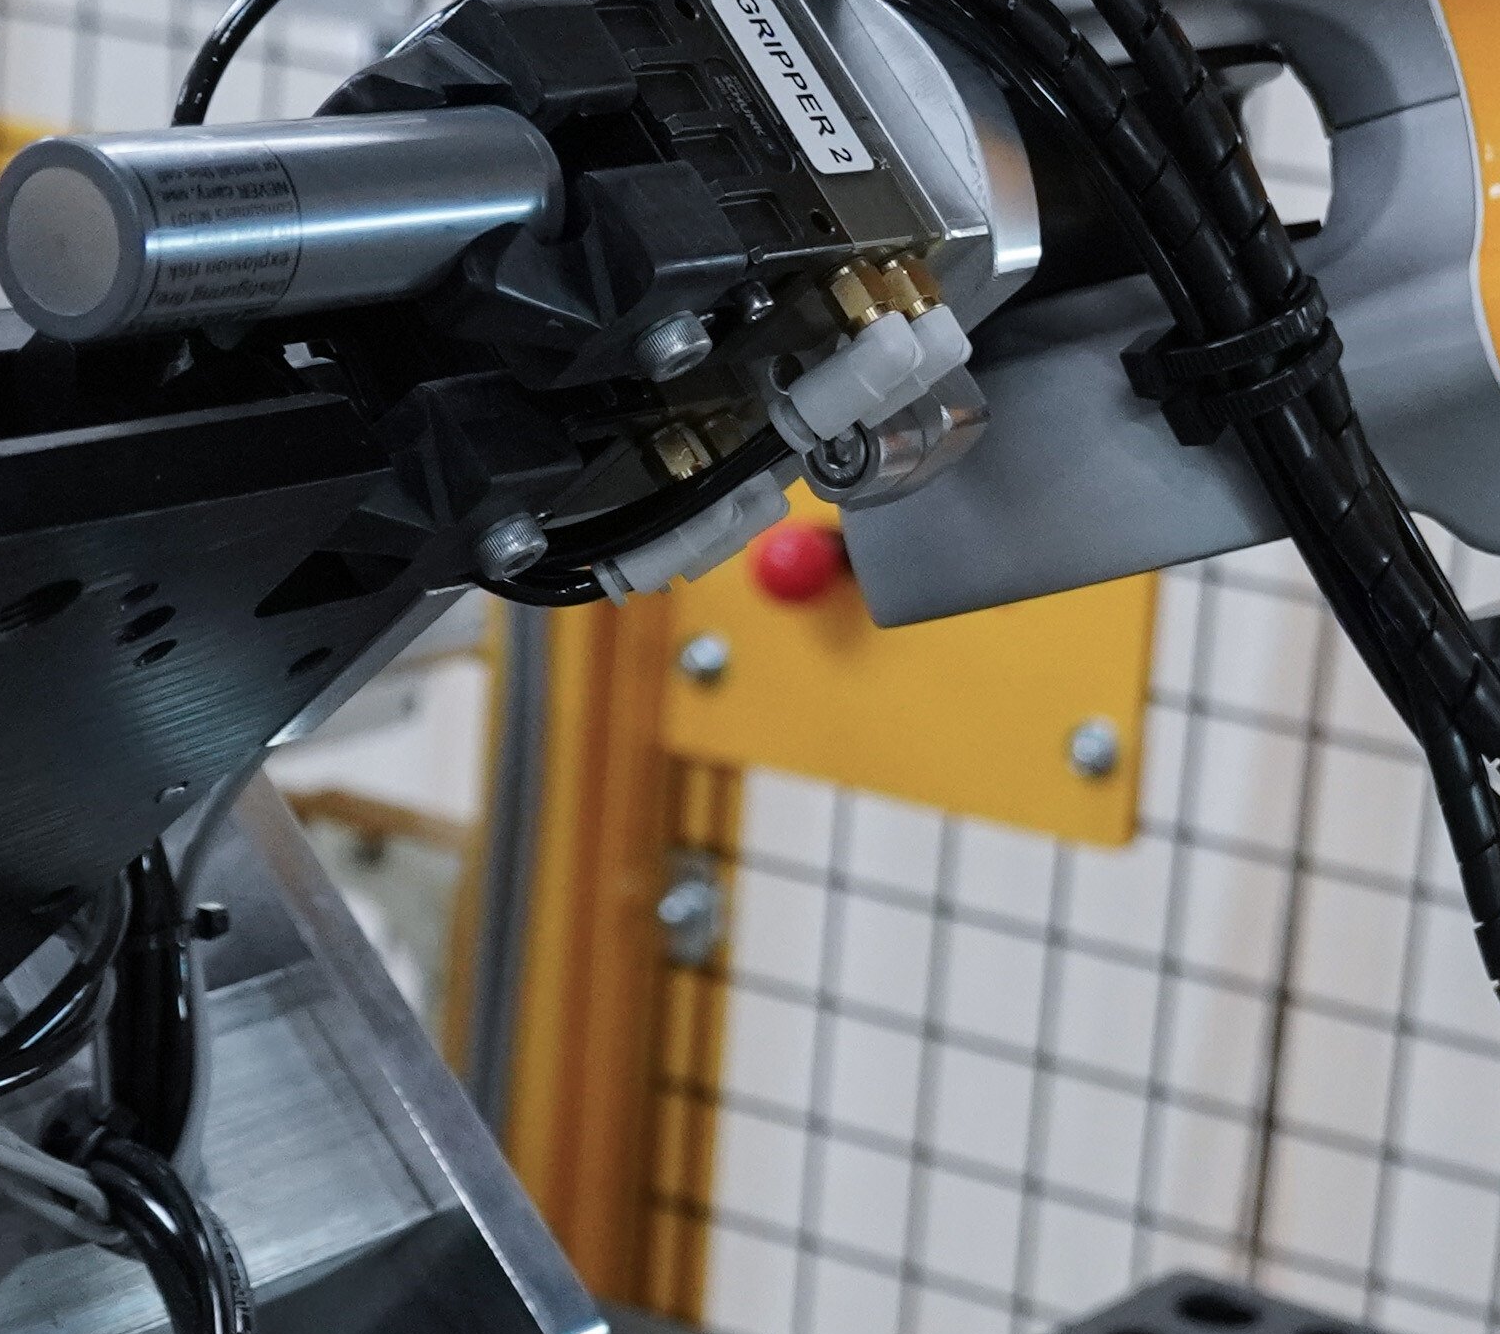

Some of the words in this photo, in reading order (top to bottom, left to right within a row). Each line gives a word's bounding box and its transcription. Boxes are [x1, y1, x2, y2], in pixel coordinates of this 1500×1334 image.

[828, 147, 854, 164] 2
[236, 179, 289, 200] NEVER
[167, 263, 202, 281] risk
[204, 250, 291, 276] explosion
